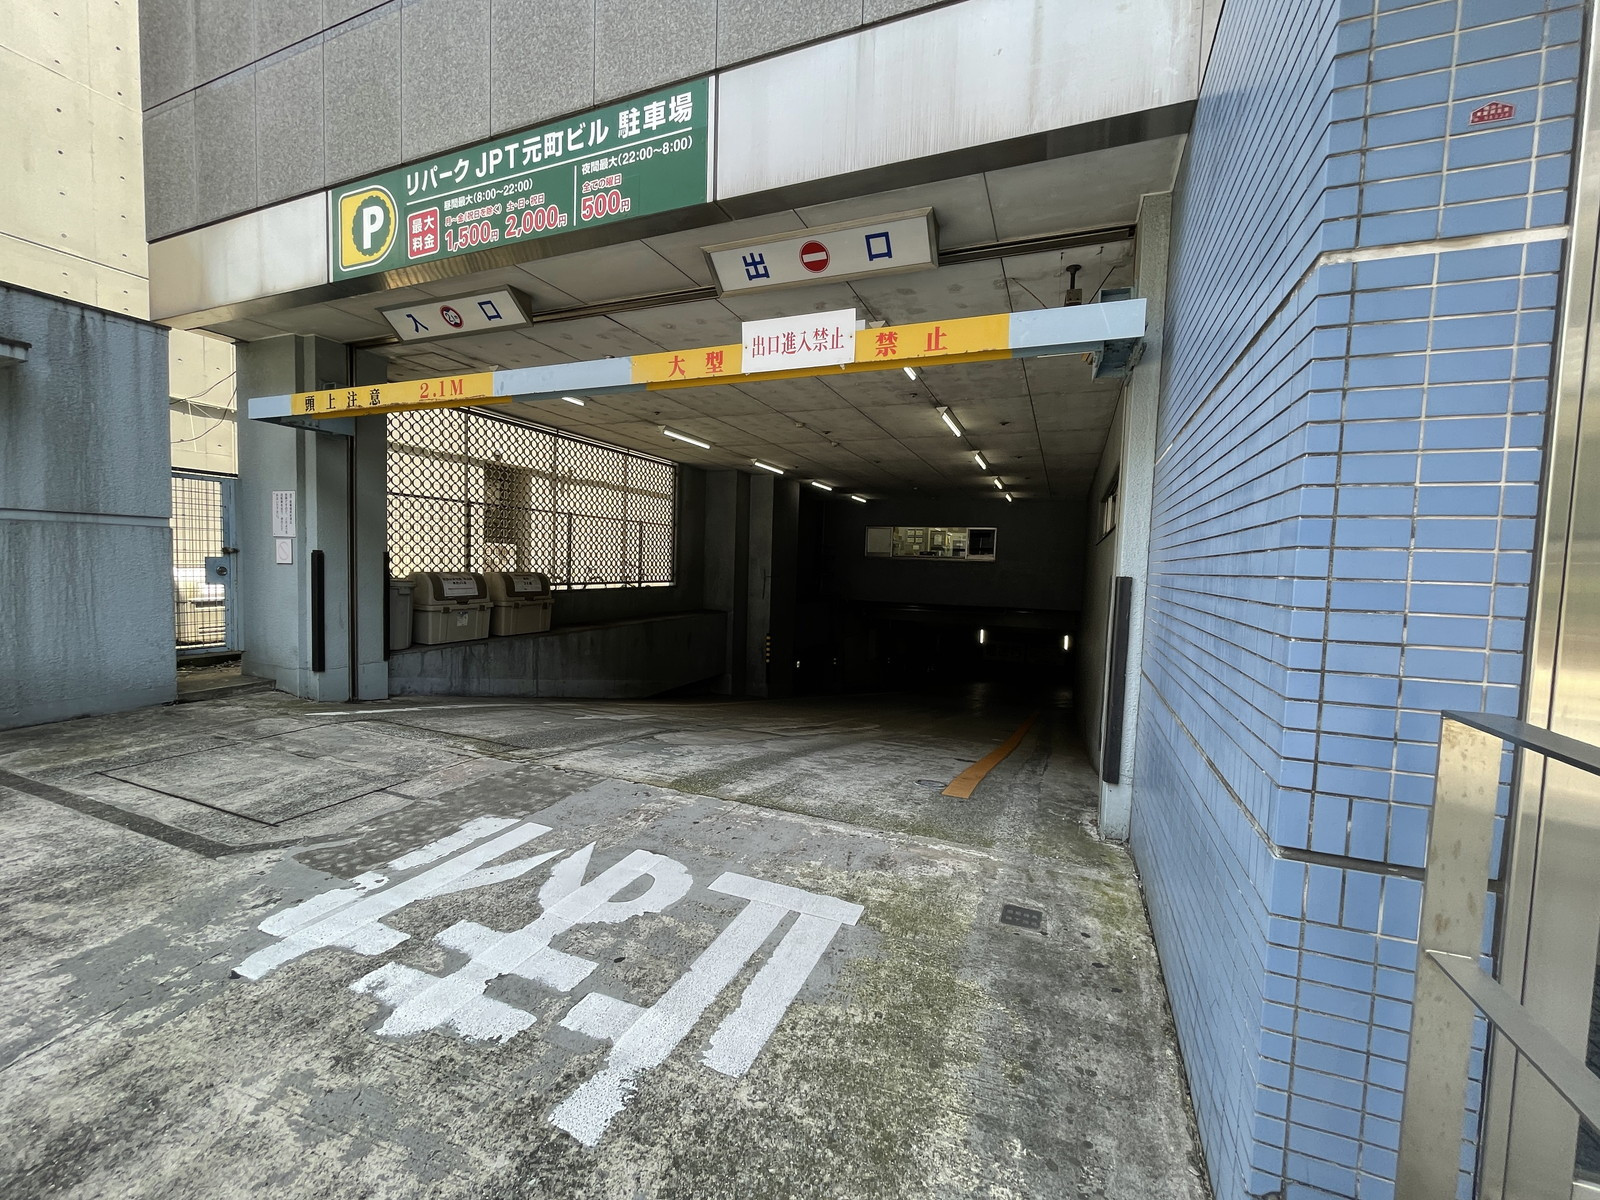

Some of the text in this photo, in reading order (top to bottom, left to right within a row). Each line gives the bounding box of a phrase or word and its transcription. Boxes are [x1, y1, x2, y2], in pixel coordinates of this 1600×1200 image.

[406, 91, 693, 196] リパーク JPT元町ビル 駐車場
[581, 173, 622, 193] 全ての曜日
[504, 204, 568, 239] 2,000円
[580, 189, 631, 221] 500円
[362, 205, 385, 250] P
[412, 215, 435, 234] 最大
[444, 220, 500, 252] 1,500円
[412, 233, 435, 253] 料金
[668, 326, 948, 378] 大型 禁止
[751, 326, 845, 359] 出口進入禁止
[304, 378, 464, 412] 頭上注意 2.1M
